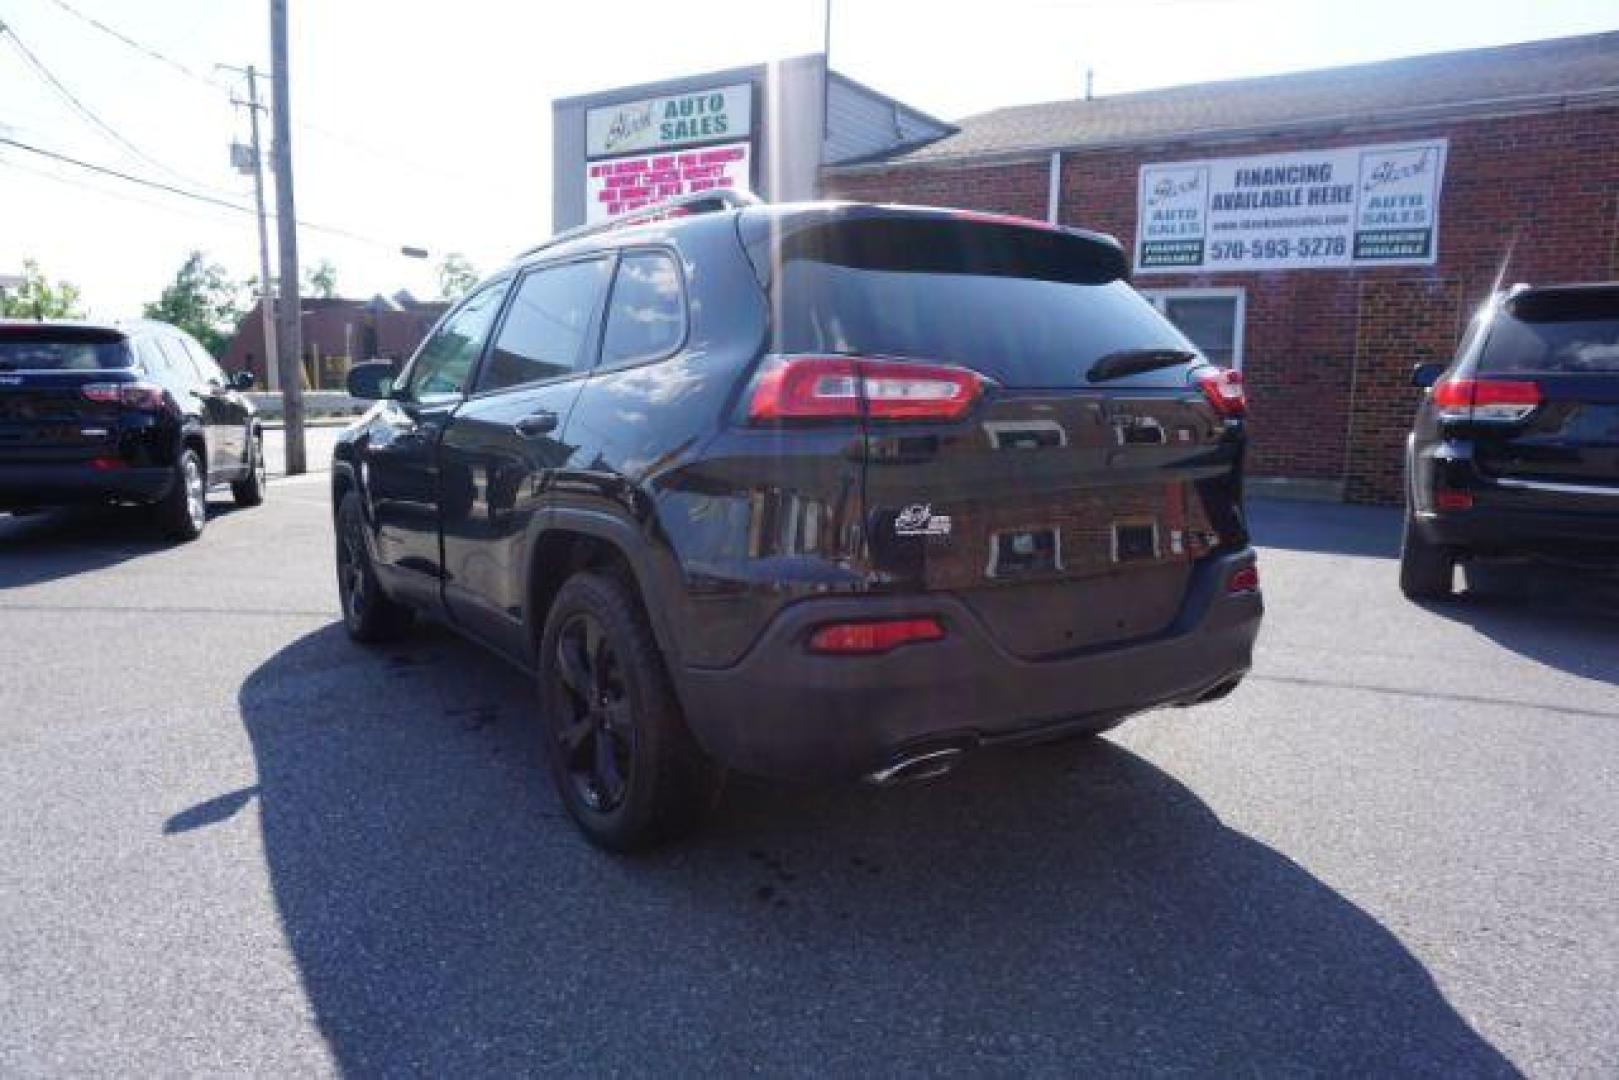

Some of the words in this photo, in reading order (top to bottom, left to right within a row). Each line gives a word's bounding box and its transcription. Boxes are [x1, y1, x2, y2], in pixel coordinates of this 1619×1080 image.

[665, 92, 724, 118] AUTO
[660, 114, 727, 139] SALES
[1235, 163, 1333, 187] FINANCING
[1212, 187, 1302, 211] AVAILABLE
[1307, 184, 1353, 206] HERE
[1211, 236, 1346, 260] 570-593-5278
